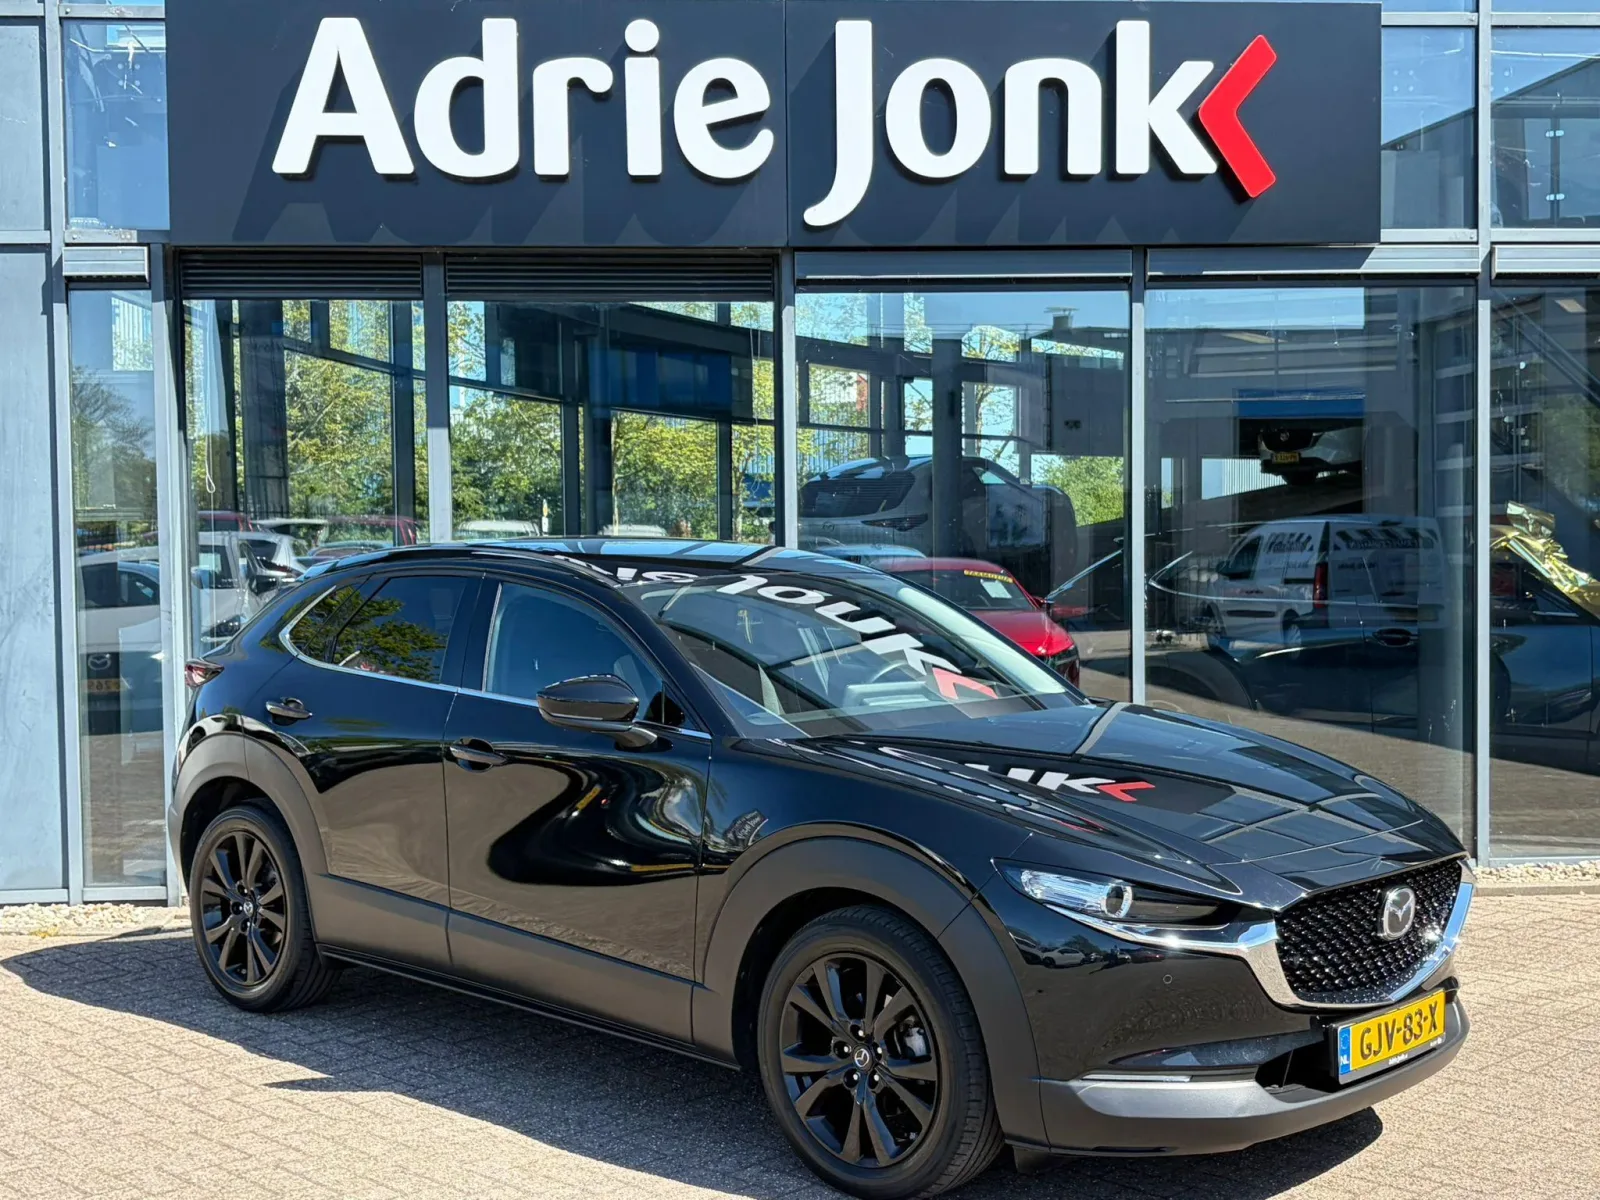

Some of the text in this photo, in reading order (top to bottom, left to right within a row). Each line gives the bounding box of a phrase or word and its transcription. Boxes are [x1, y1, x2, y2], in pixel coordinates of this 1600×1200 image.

[272, 17, 1218, 226] Adrie Jonk
[1340, 1055, 1350, 1065] NL
[1360, 1001, 1438, 1060] GJV-83-X
